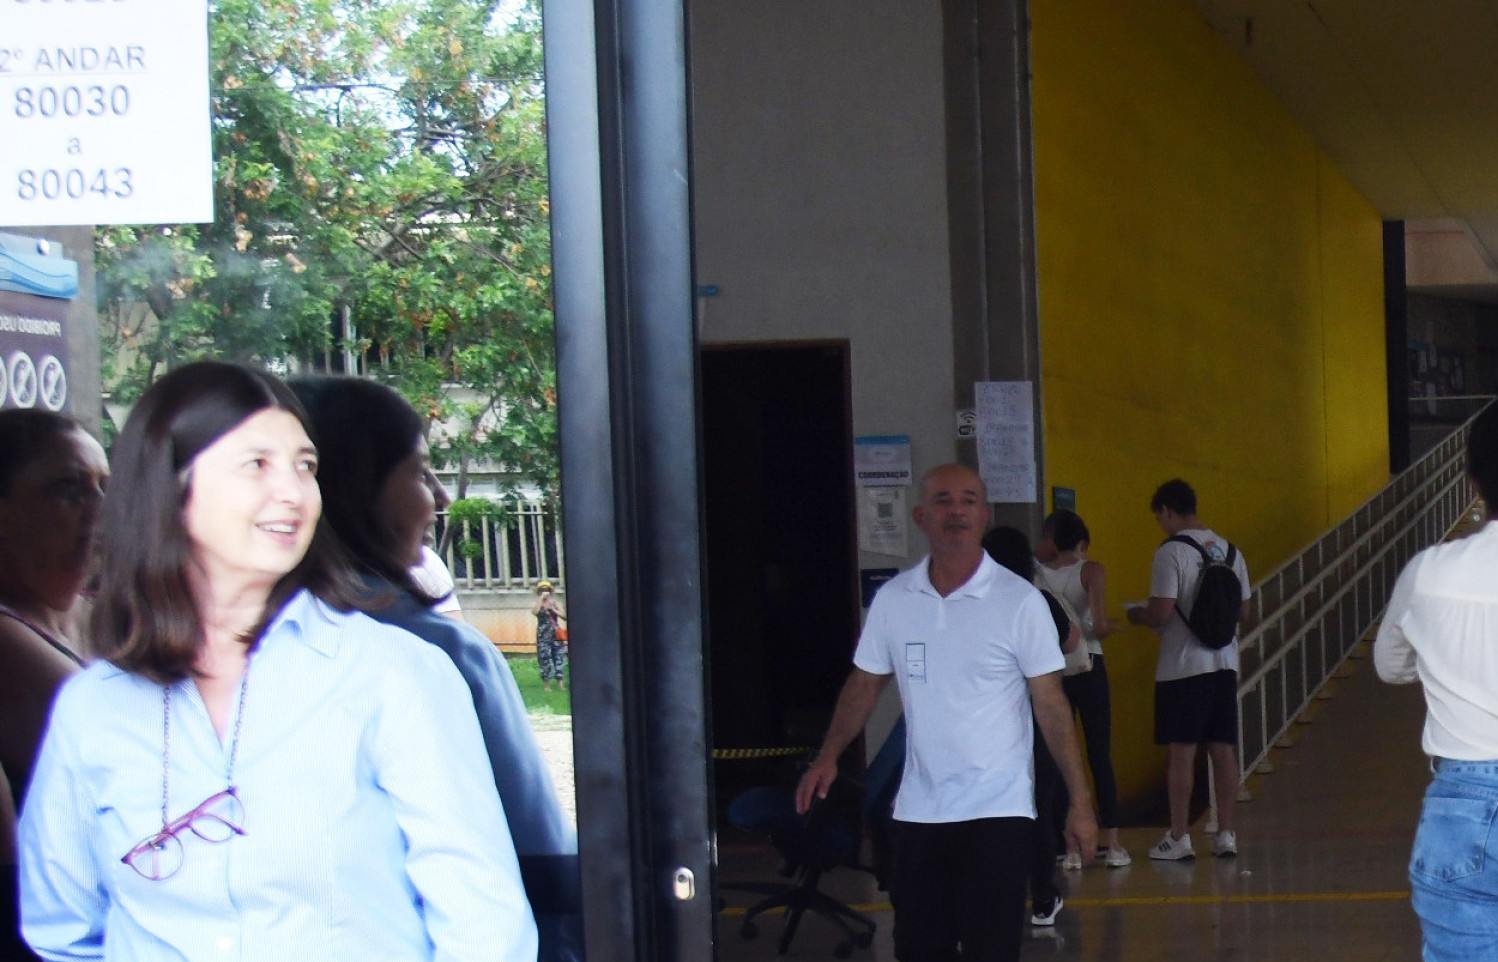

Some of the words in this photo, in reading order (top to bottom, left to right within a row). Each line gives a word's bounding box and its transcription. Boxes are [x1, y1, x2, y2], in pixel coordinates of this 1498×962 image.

[35, 46, 146, 72] ANDAR
[14, 84, 131, 119] 80030
[66, 136, 83, 156] a
[17, 167, 134, 201] 80043
